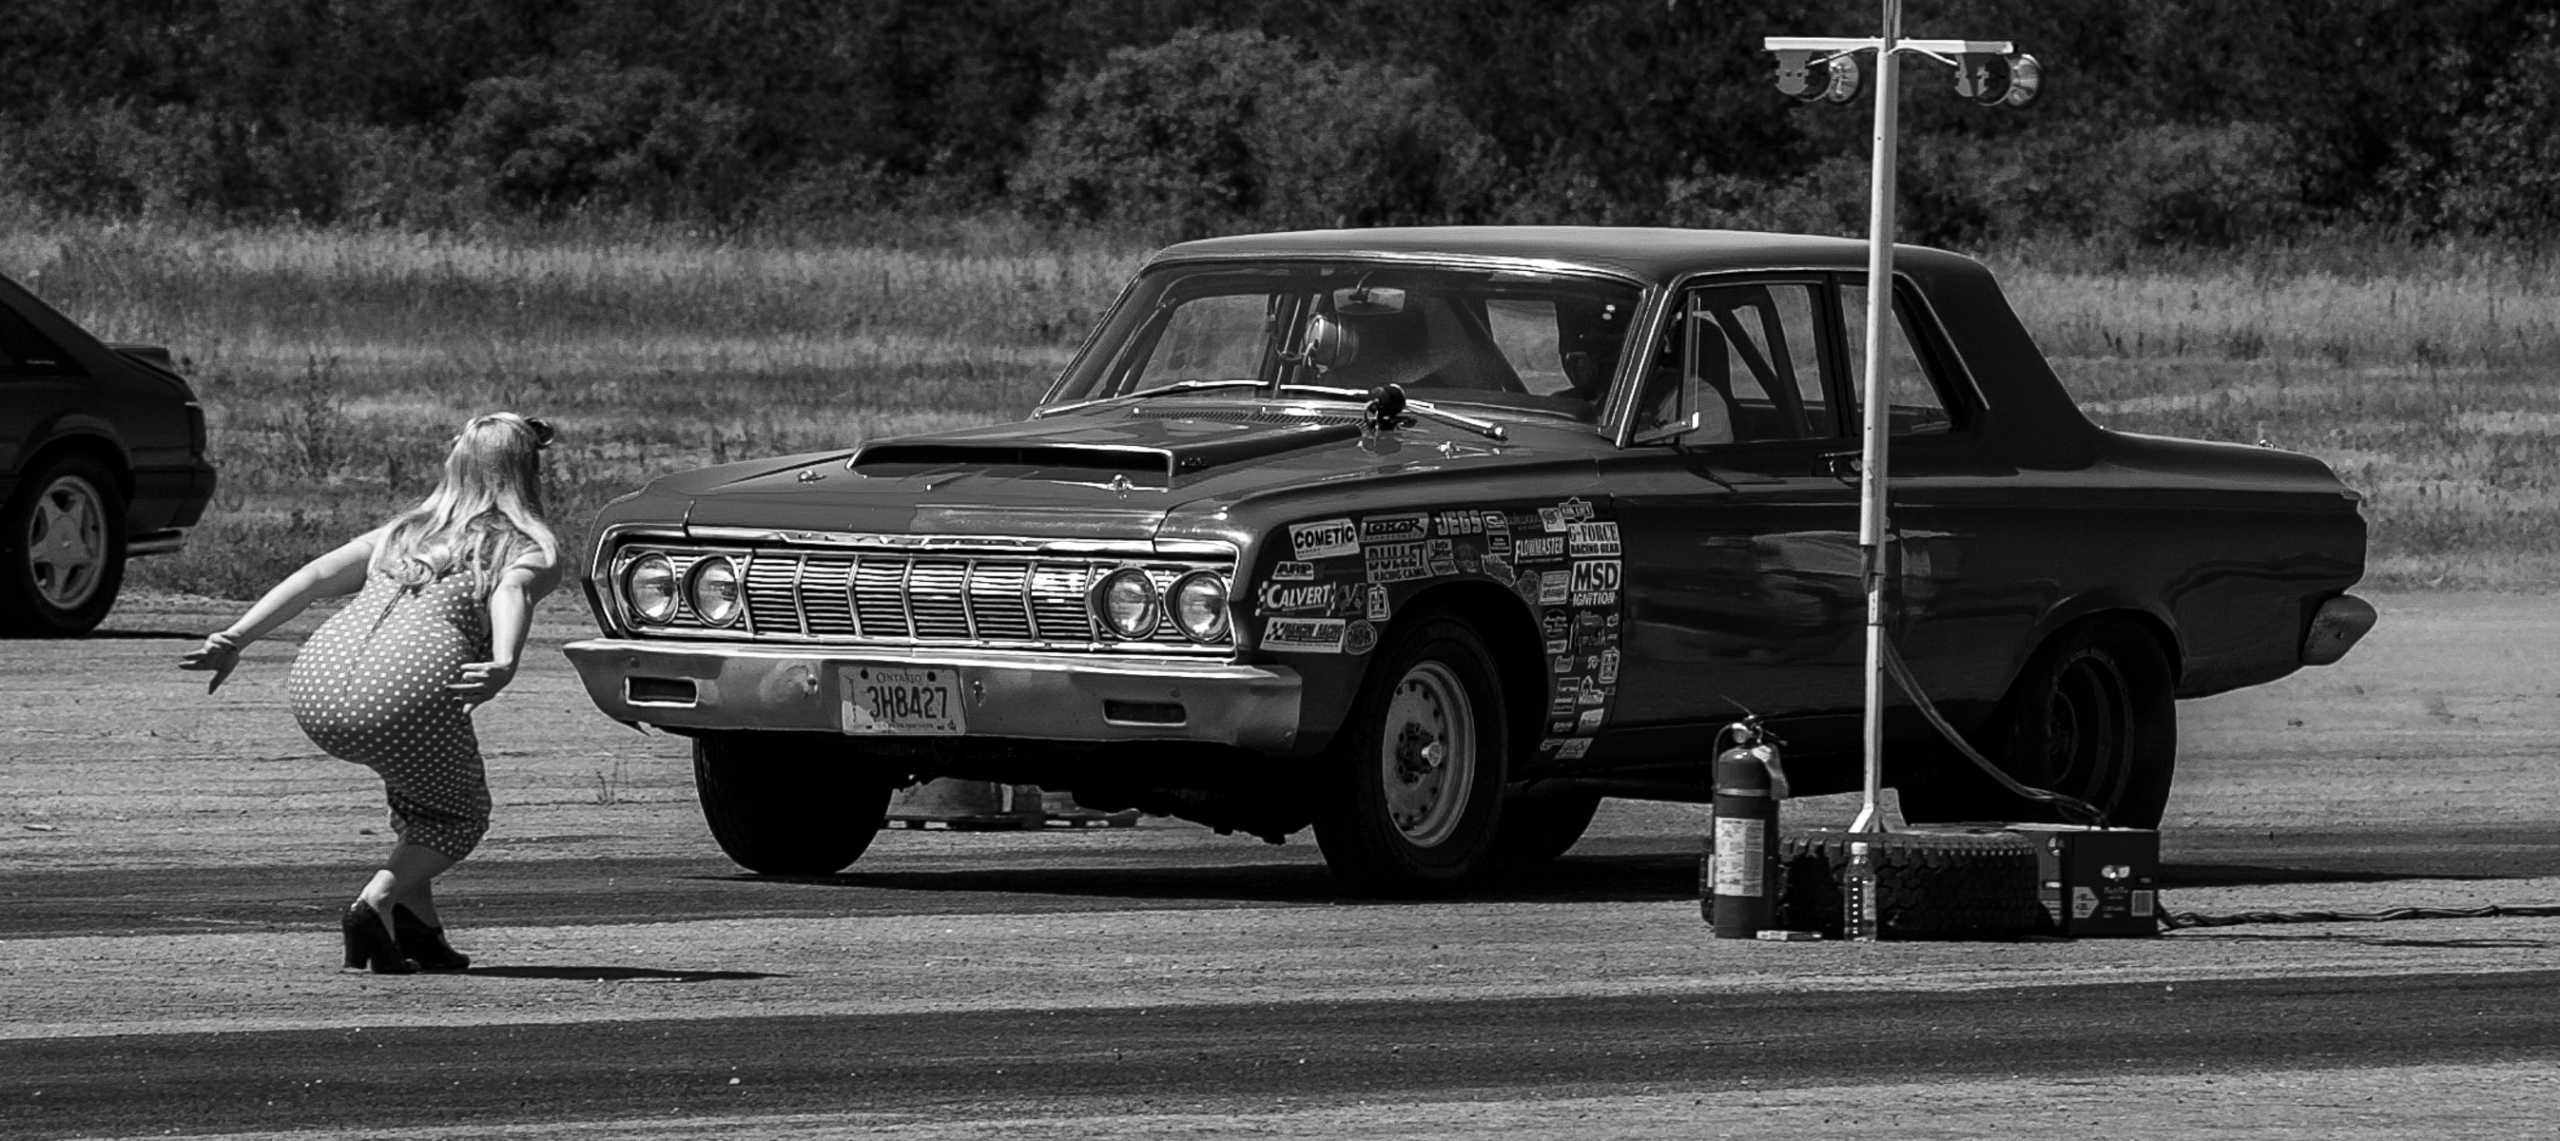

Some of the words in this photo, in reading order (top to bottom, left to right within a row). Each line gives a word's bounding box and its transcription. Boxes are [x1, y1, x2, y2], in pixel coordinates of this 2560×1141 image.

[1366, 518, 1424, 535] LOKAR
[1434, 510, 1483, 535] JEGS
[1570, 523, 1618, 543] G-FORCE
[1294, 525, 1355, 549] COMETIC
[1571, 543, 1599, 554] RACING
[1600, 543, 1620, 554] GEAR
[1368, 544, 1425, 571] BULLET
[1514, 537, 1565, 564] FLOWMASTER
[1276, 562, 1313, 575] ARP
[1574, 561, 1619, 591] MSD
[1267, 584, 1332, 608] CALVERT
[1572, 591, 1616, 607] IGNITION
[867, 686, 947, 720] 3H8427
